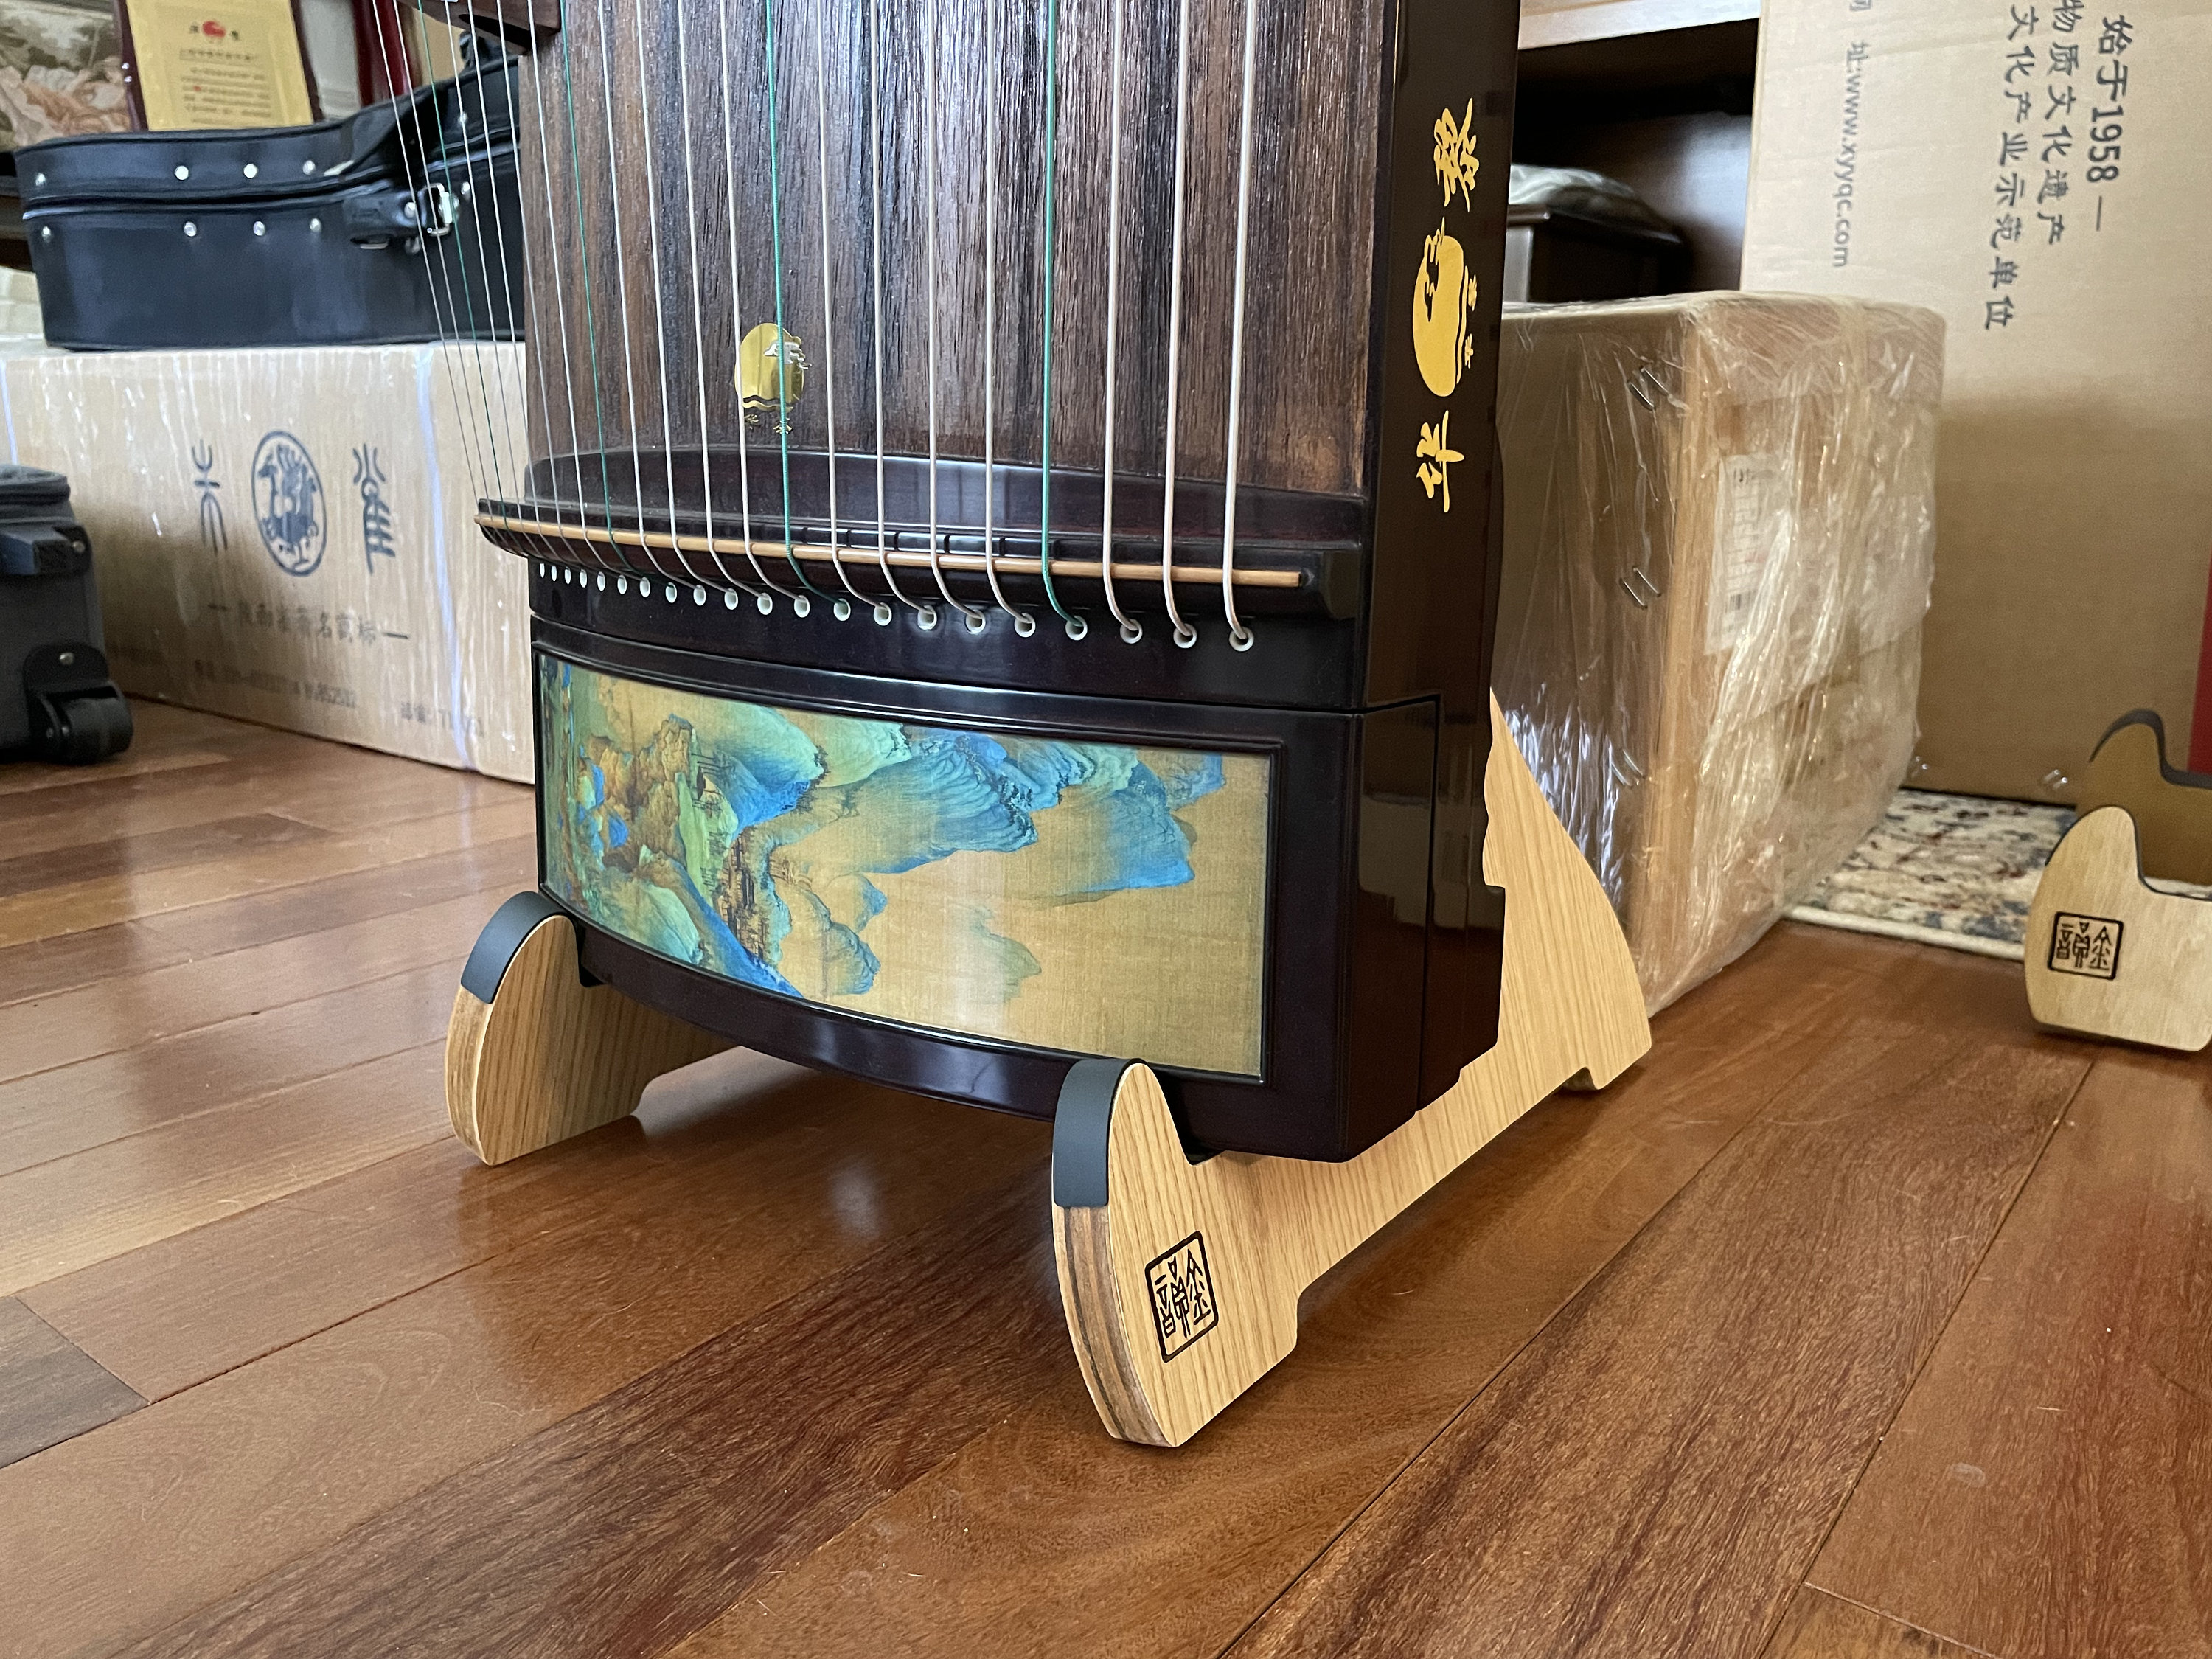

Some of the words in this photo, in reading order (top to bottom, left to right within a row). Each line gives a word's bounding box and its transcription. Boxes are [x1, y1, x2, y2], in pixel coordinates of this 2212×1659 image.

[1985, 4, 2039, 330] 文化产业示范单位
[2037, 0, 2084, 246] 物质文化遗产
[2086, 15, 2134, 184] 始于1958
